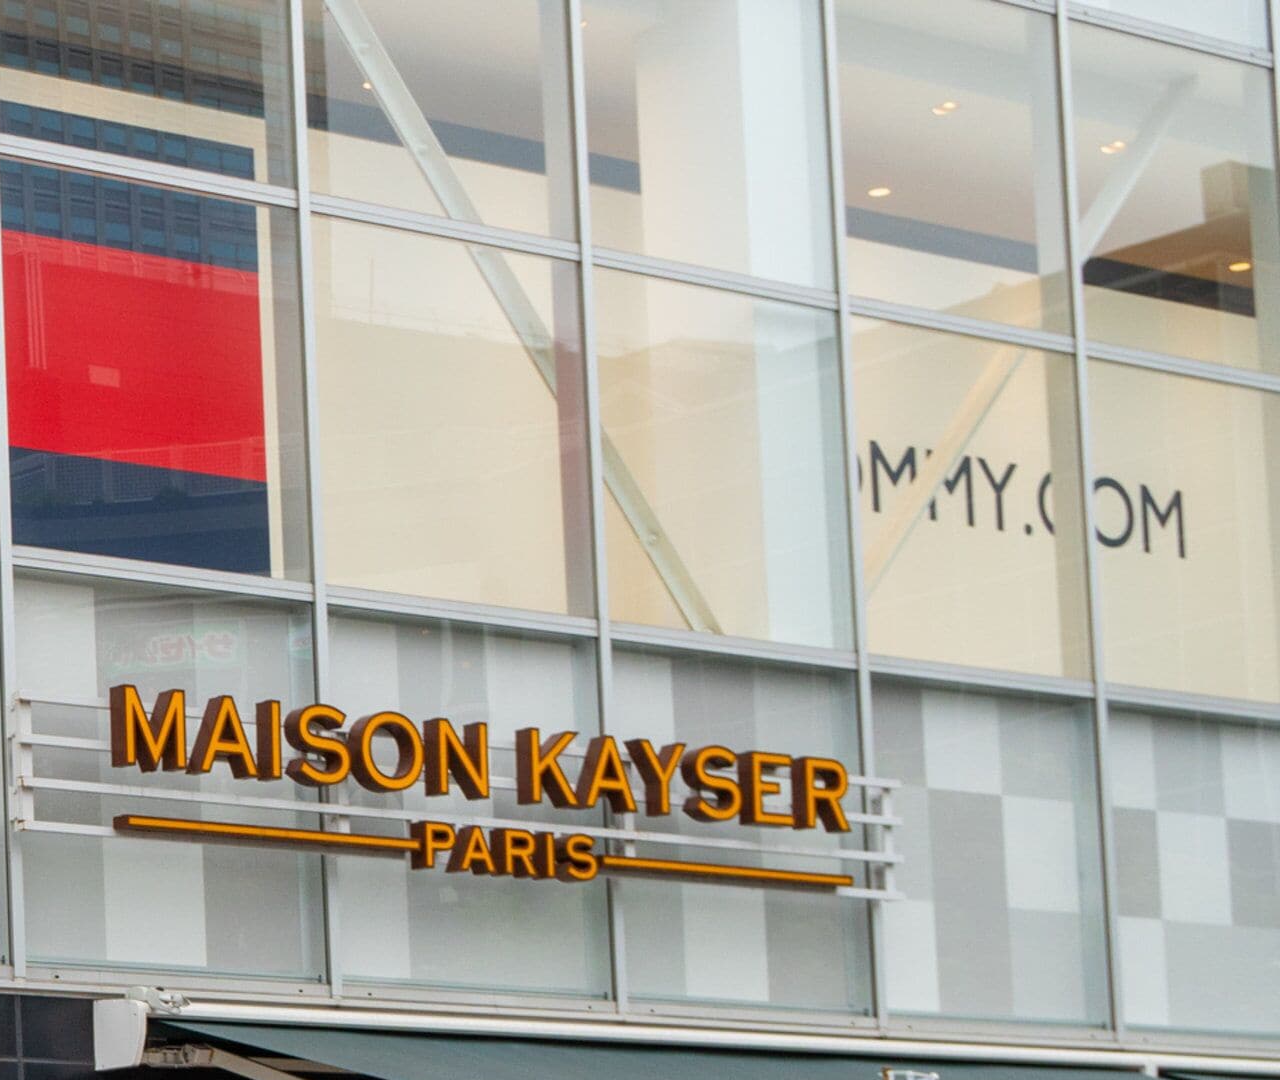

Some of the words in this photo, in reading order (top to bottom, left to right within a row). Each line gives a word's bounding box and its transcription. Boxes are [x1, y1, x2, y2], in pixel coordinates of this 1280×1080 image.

[857, 440, 1187, 559] MMY.COM
[110, 684, 490, 800] MAISON
[515, 727, 852, 832] KAYSER
[411, 821, 599, 881] PARIS
